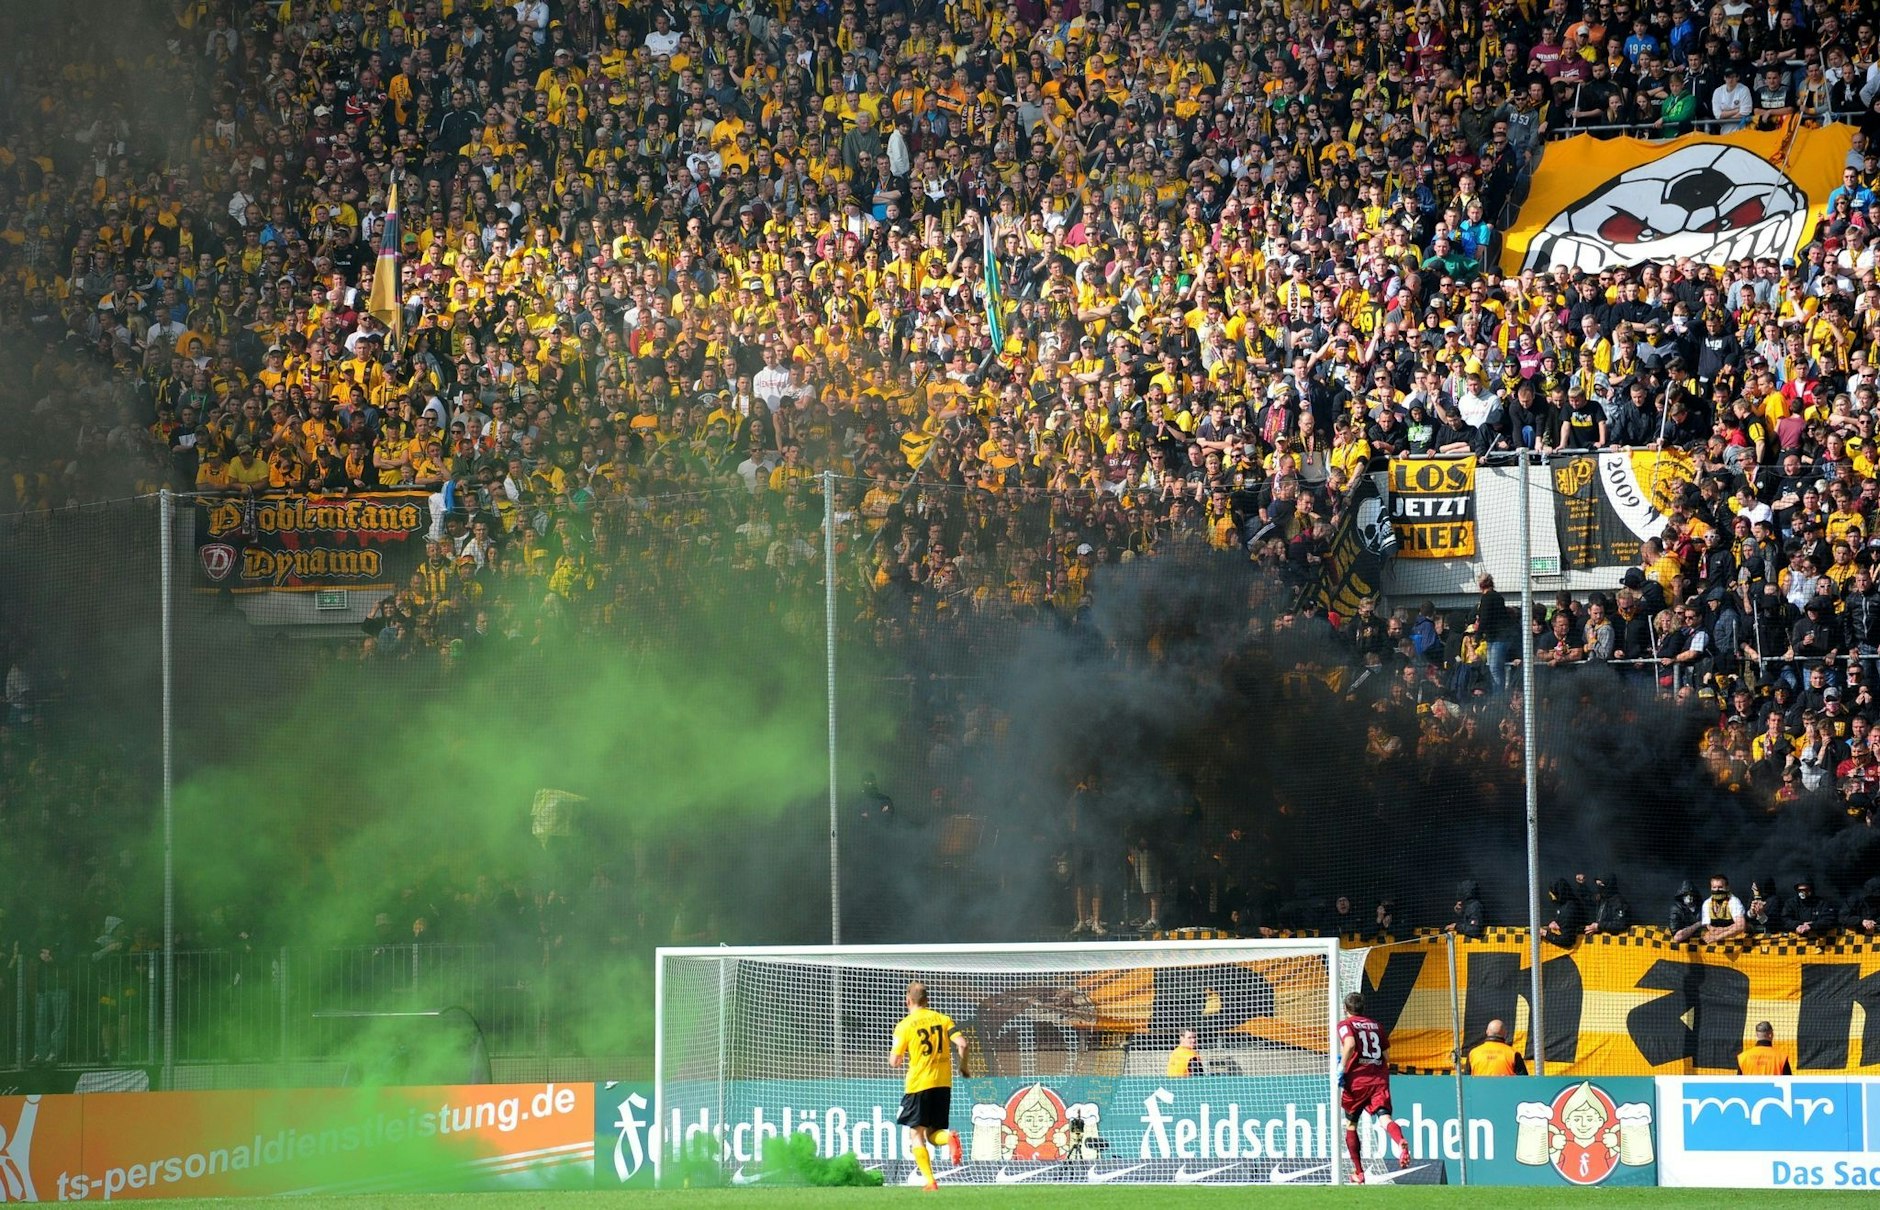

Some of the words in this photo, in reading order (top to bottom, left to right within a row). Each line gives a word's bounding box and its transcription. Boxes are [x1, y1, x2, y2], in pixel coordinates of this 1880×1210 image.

[1509, 112, 1530, 126] 1953
[1394, 463, 1471, 493] LOS
[1606, 457, 1641, 508] 2009
[208, 498, 421, 537] Poblemfans
[1392, 495, 1471, 518] JETZT
[1397, 524, 1469, 552] HIER
[242, 547, 382, 586] Dynamo
[917, 1024, 944, 1057] 37
[1358, 1030, 1383, 1060] 13
[1683, 1083, 1835, 1126] mdr
[56, 1084, 577, 1201] ts-personaldienstleistung.de
[1772, 1162, 1824, 1186] Das
